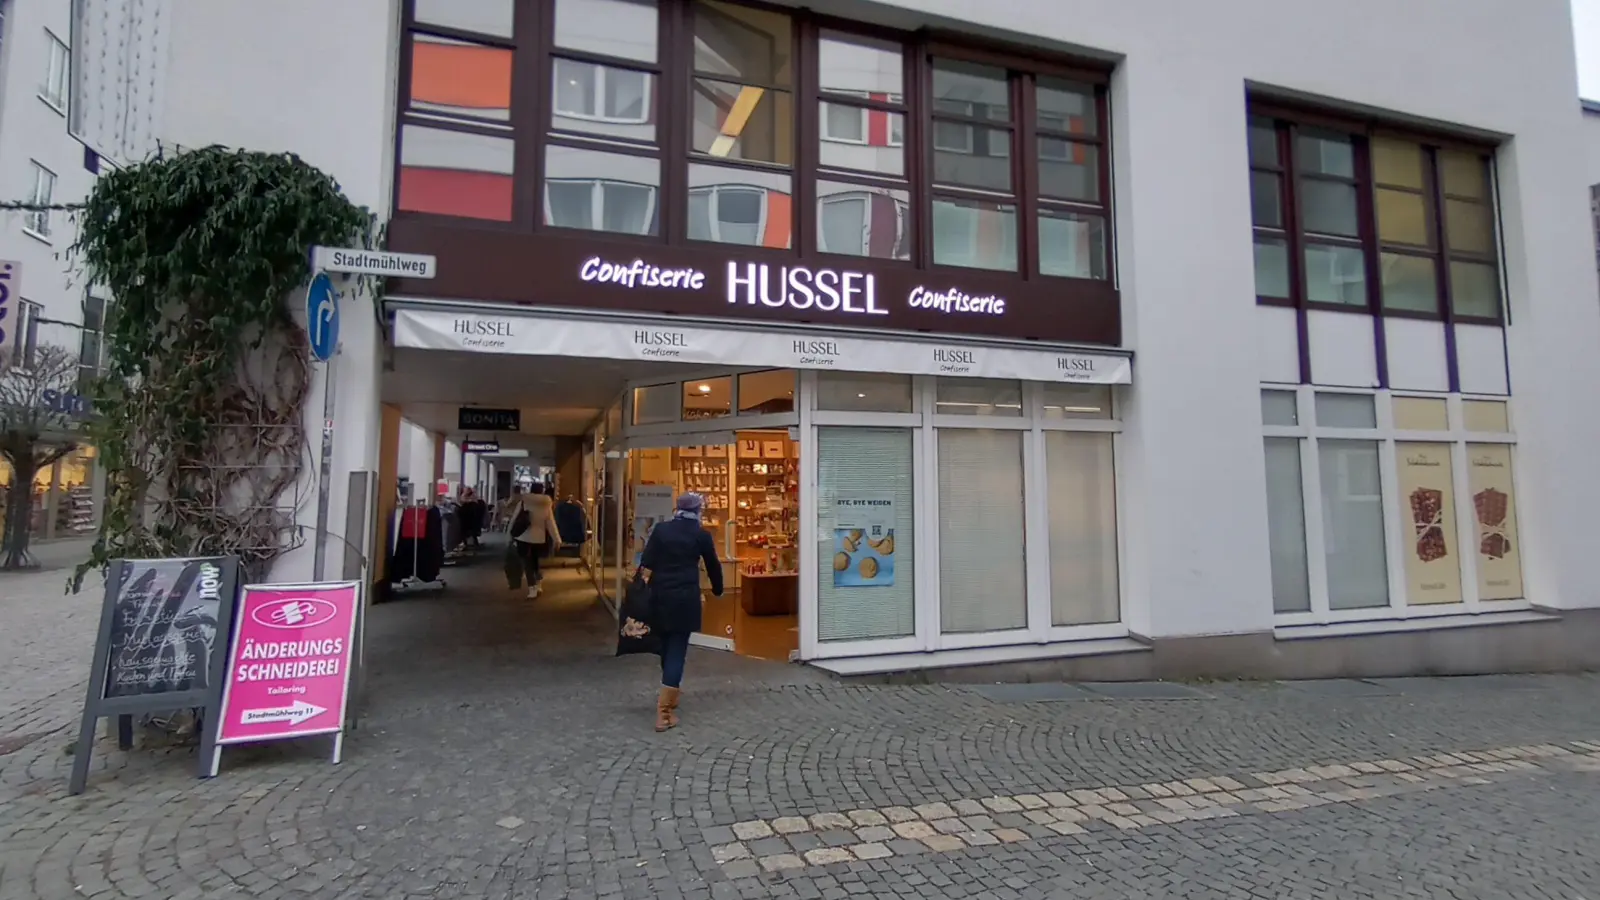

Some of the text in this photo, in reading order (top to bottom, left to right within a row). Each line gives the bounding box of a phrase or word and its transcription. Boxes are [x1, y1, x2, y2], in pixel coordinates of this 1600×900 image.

[333, 251, 427, 275] Stadtmühlweg
[580, 256, 1005, 314] Confiserie HUSSEL Confiserie
[454, 319, 515, 337] HUSSEL
[462, 337, 505, 347] Confiserie
[635, 330, 688, 347] HUSSEL
[642, 348, 680, 357] Confiserie
[793, 340, 840, 356] HUSSEL
[933, 349, 976, 364] HUSSEL
[1058, 357, 1096, 371] HUSSEL
[240, 638, 343, 660] ÄNDERUNGS
[237, 658, 340, 682] SCHNEIDEREI
[267, 685, 306, 695] Tailoring
[247, 707, 314, 720] Stadtmühlweg 11
